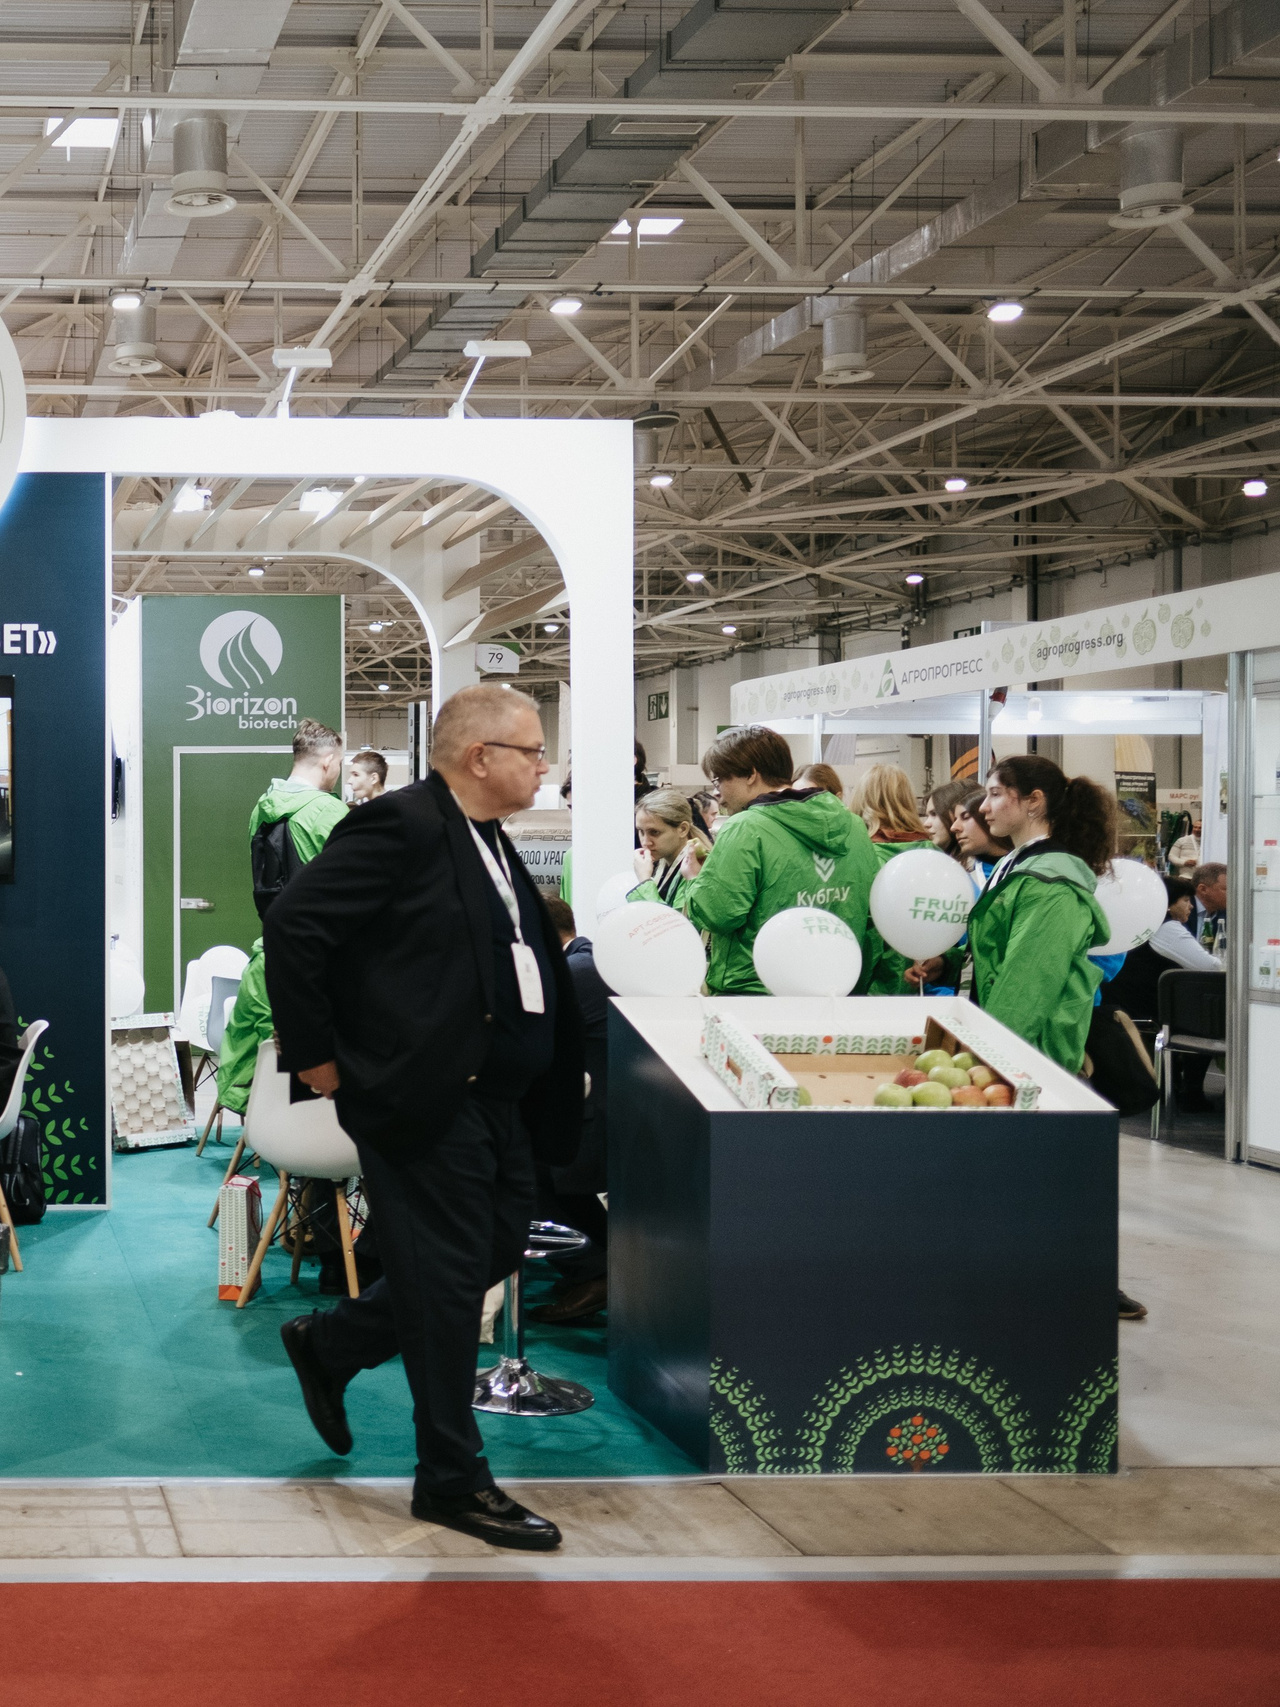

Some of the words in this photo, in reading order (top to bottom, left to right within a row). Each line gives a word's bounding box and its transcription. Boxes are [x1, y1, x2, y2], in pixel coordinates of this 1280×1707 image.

[1036, 632, 1123, 660] agroprogress.org
[488, 653, 503, 663] 79
[901, 658, 983, 685] АГРОПРОГРЕСС
[186, 685, 297, 720] Biorizon
[783, 683, 837, 701] agroprogress.org
[239, 715, 297, 729] biotech
[797, 886, 850, 907] КубГАУ
